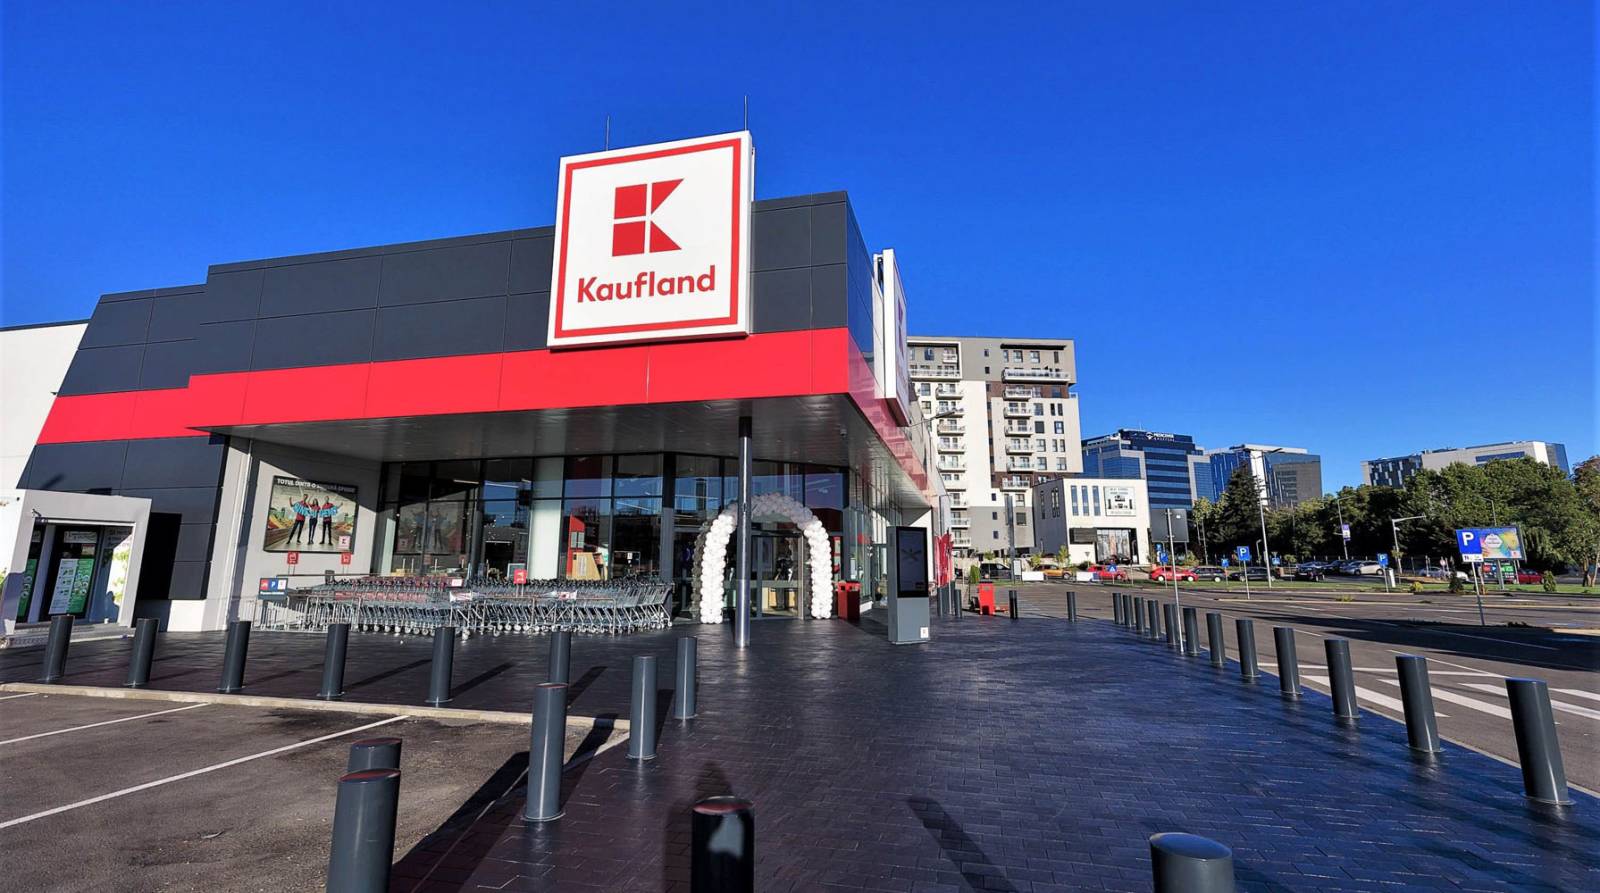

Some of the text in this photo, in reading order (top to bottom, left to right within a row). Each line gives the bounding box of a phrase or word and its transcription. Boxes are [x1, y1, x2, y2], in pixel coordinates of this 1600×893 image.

[577, 264, 716, 303] Kaufland
[1462, 531, 1474, 546] P
[1239, 547, 1247, 557] P
